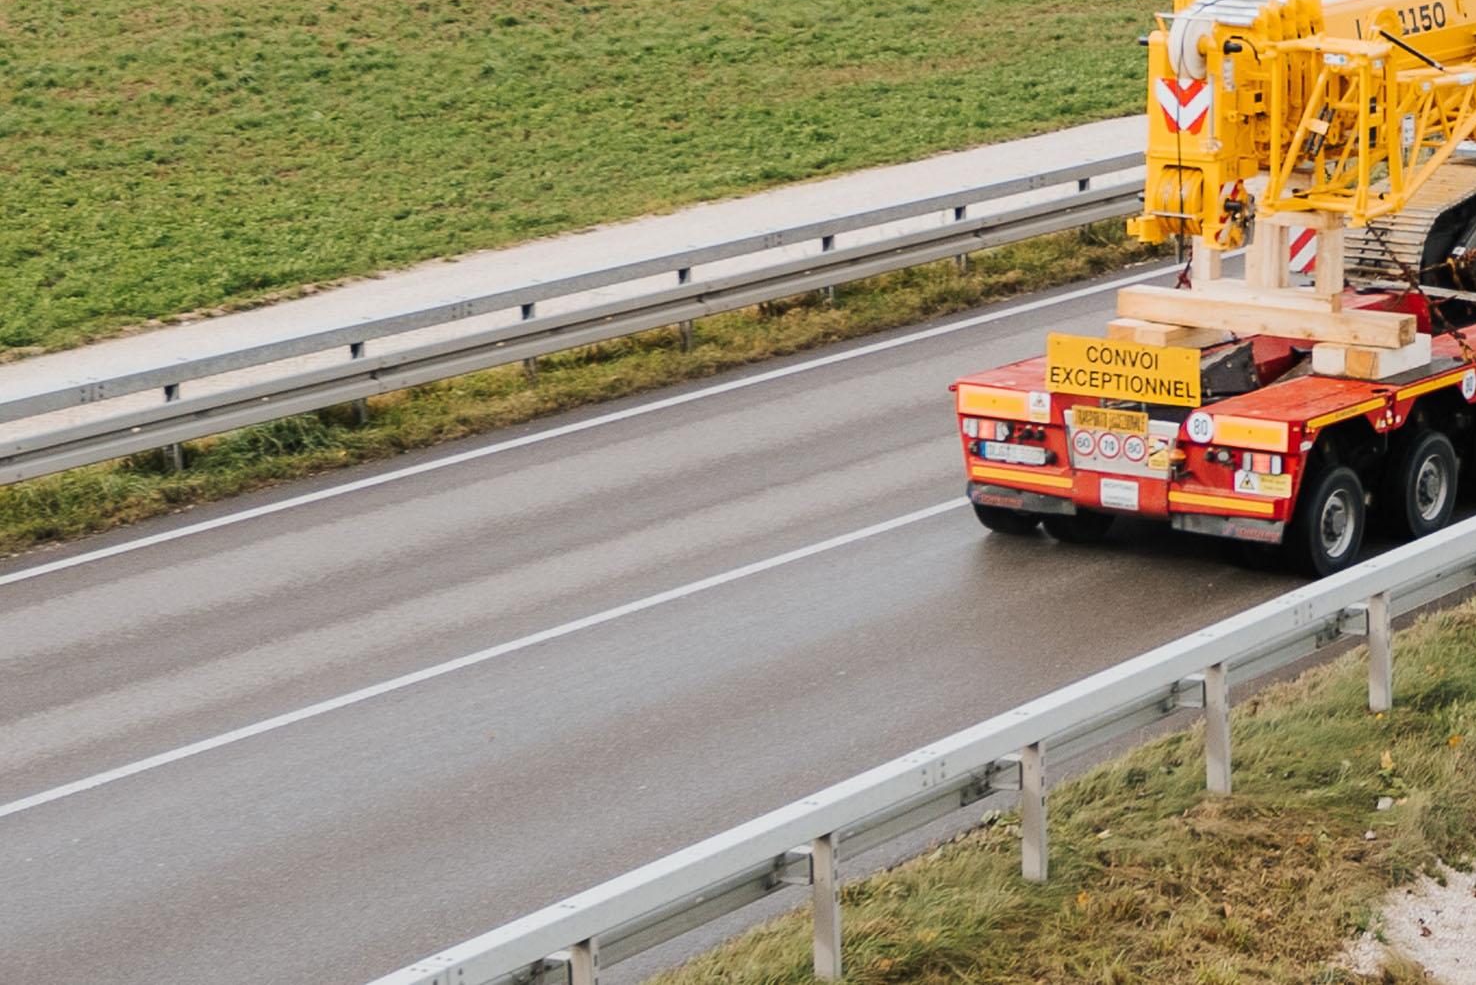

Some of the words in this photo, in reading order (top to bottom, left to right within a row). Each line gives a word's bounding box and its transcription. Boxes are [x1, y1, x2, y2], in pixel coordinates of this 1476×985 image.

[1398, 1, 1446, 36] 1150
[1086, 345, 1159, 370] CONVOI
[1050, 366, 1196, 399] EXCEPTIONNEL
[1194, 418, 1208, 436] 80
